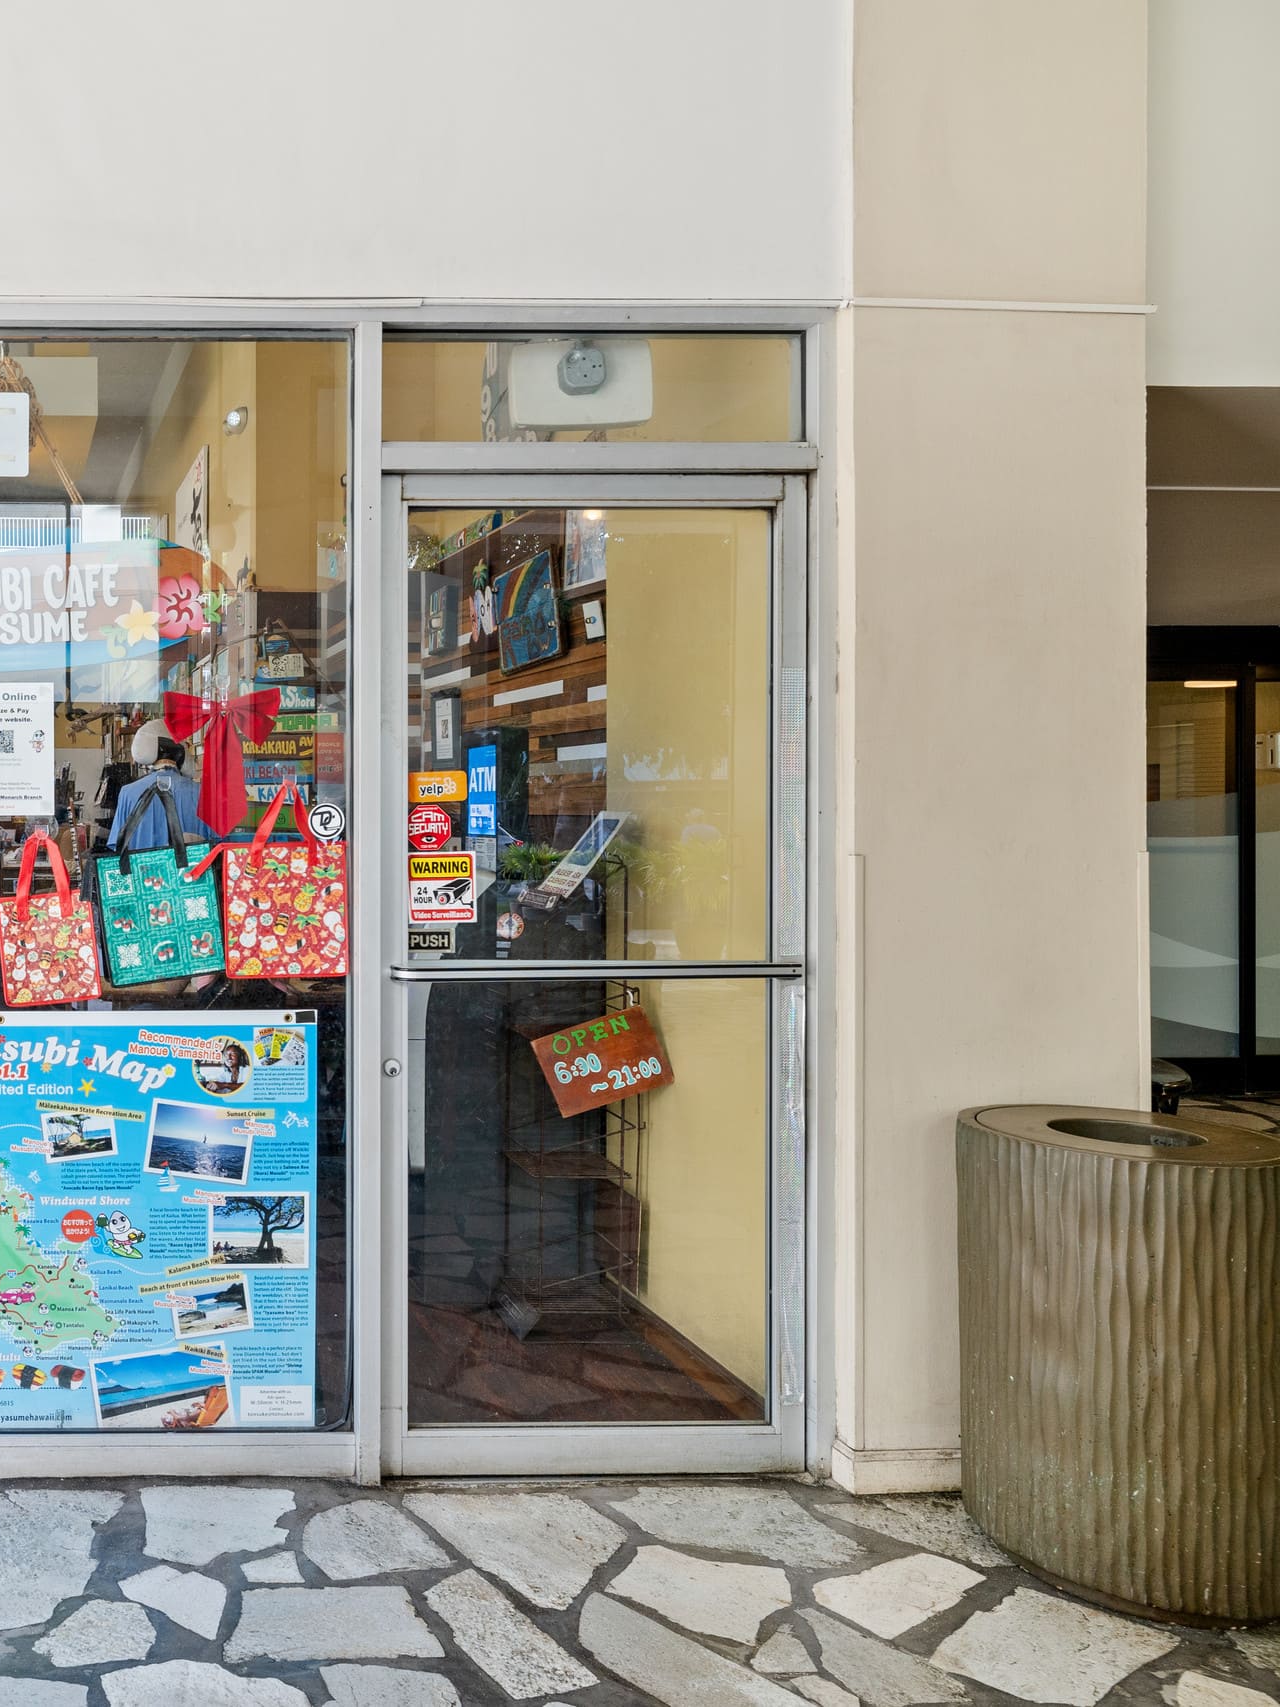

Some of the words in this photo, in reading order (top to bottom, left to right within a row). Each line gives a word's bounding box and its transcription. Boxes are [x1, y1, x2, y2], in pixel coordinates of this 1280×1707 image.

[43, 563, 120, 609] CAFE
[2, 692, 37, 701] Online
[285, 685, 315, 708] Shore
[259, 765, 296, 779] BEACH
[469, 766, 496, 793] ATM
[419, 783, 444, 797] yelp
[411, 811, 445, 822] CAM
[408, 822, 448, 836] SECURITY
[412, 861, 468, 874] WARNING
[417, 886, 428, 895] 24
[414, 896, 433, 904] HOUR
[414, 911, 431, 919] Video
[432, 911, 472, 919] Surveillance
[410, 934, 448, 947] PUSH
[140, 1030, 211, 1049] Recommended
[552, 1014, 631, 1055] OPEN
[130, 1044, 168, 1056] Manoue
[172, 1047, 221, 1060] Yamashita
[87, 1044, 169, 1094] Map
[554, 1052, 602, 1084] 6:30
[27, 1084, 74, 1095] Edition
[96, 1109, 127, 1118] Recreation
[40, 1195, 96, 1206] Windward
[99, 1195, 131, 1205] Shore
[168, 1265, 191, 1275] Kalama
[191, 1261, 210, 1270] Beach
[210, 1256, 224, 1265] Park
[140, 1285, 158, 1293] Beach
[166, 1282, 183, 1290] front
[189, 1278, 210, 1287] Halona
[211, 1275, 225, 1283] Blow
[184, 1344, 206, 1354] Waikiki
[206, 1348, 224, 1358] Beach
